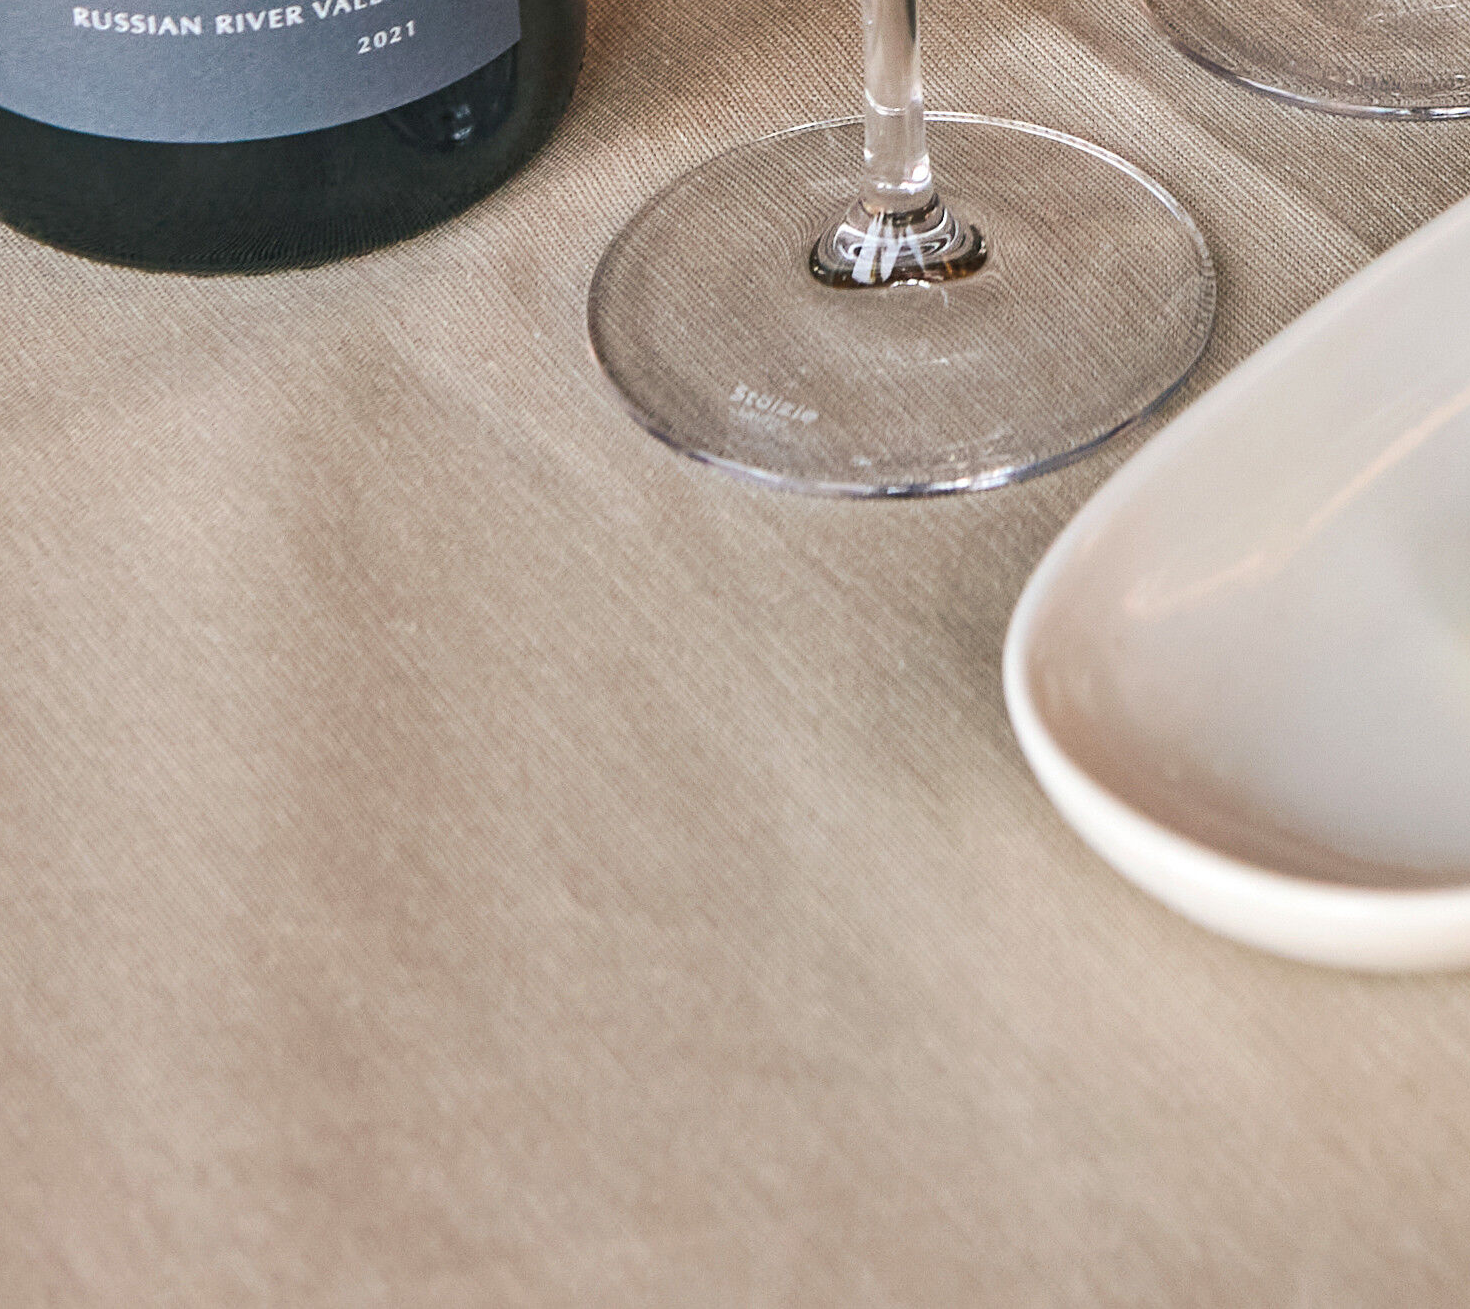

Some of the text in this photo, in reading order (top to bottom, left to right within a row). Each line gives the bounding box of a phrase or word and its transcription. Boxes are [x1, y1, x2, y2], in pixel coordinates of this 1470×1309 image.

[72, 6, 203, 35] RUSSIAN
[214, 5, 304, 34] RIVER
[357, 20, 416, 55] 2021
